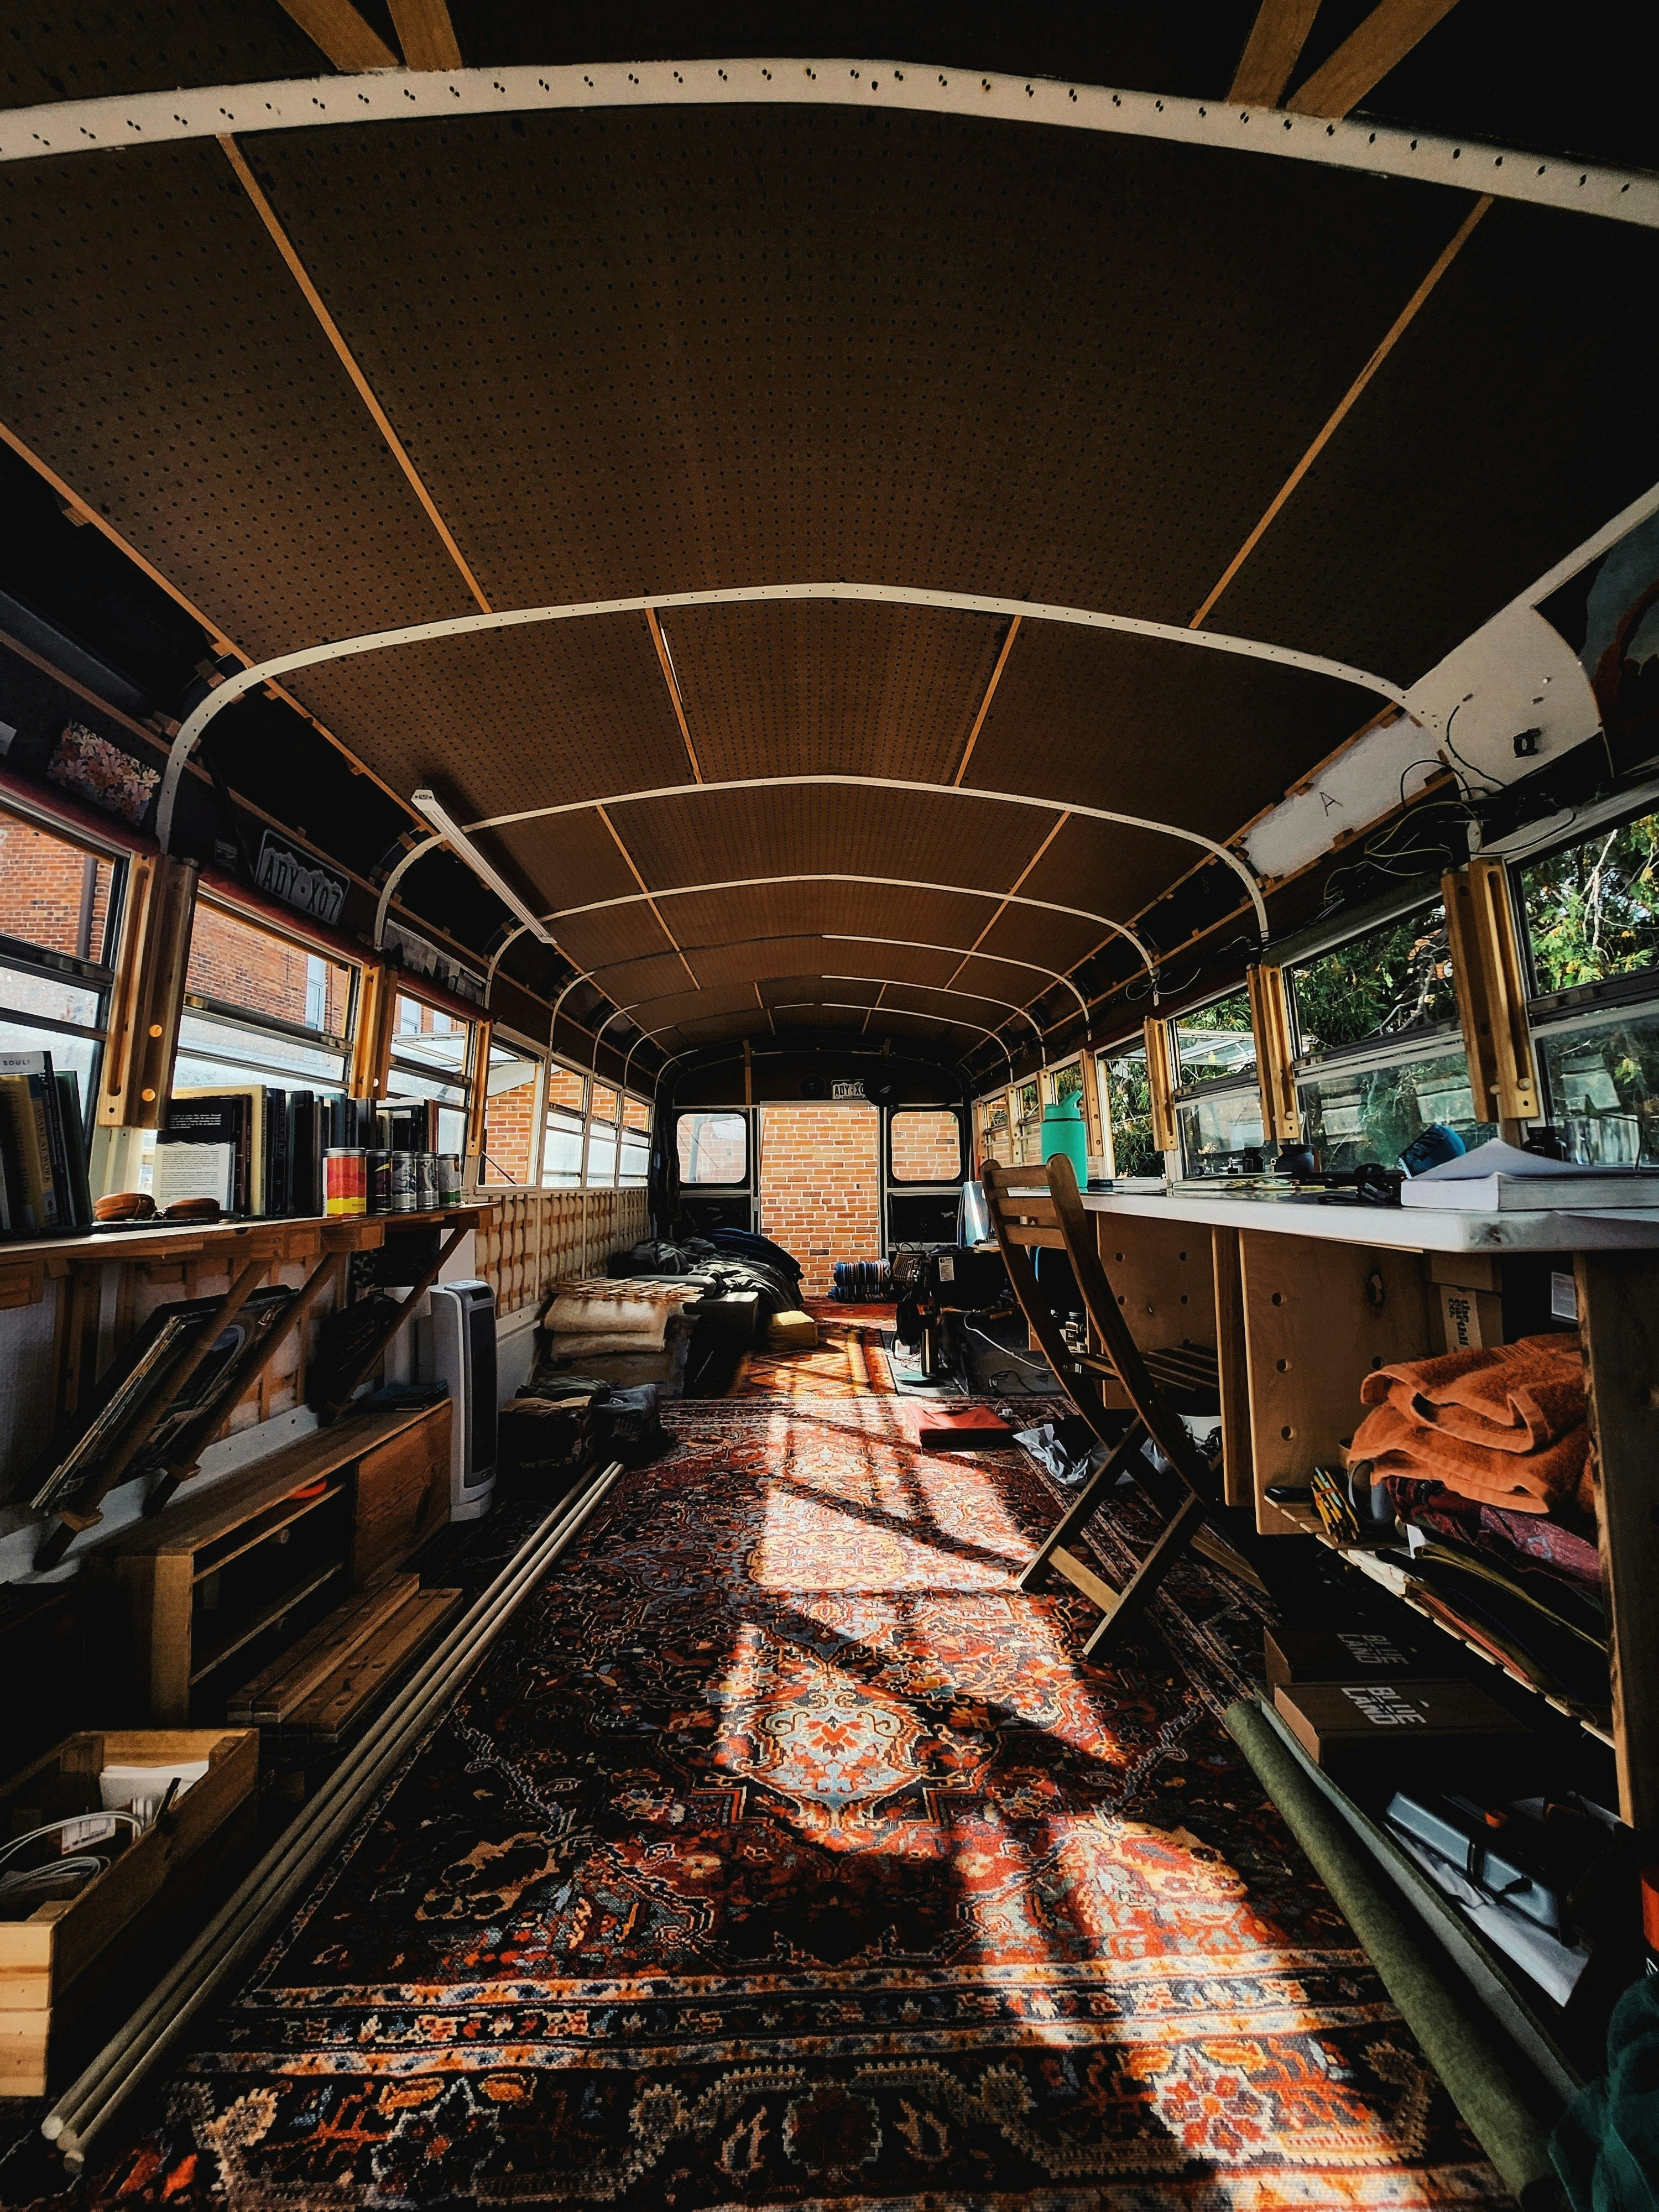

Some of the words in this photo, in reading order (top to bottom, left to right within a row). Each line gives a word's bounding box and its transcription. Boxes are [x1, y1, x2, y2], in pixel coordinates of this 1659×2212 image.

[1319, 791, 1343, 817] A
[835, 1086, 849, 1095] ADY
[855, 1085, 863, 1095] X0
[1336, 1633, 1383, 1663] LAND
[1361, 1634, 1410, 1665] BLUE
[1340, 1688, 1399, 1724] LAND
[1366, 1687, 1428, 1724] BLUE
